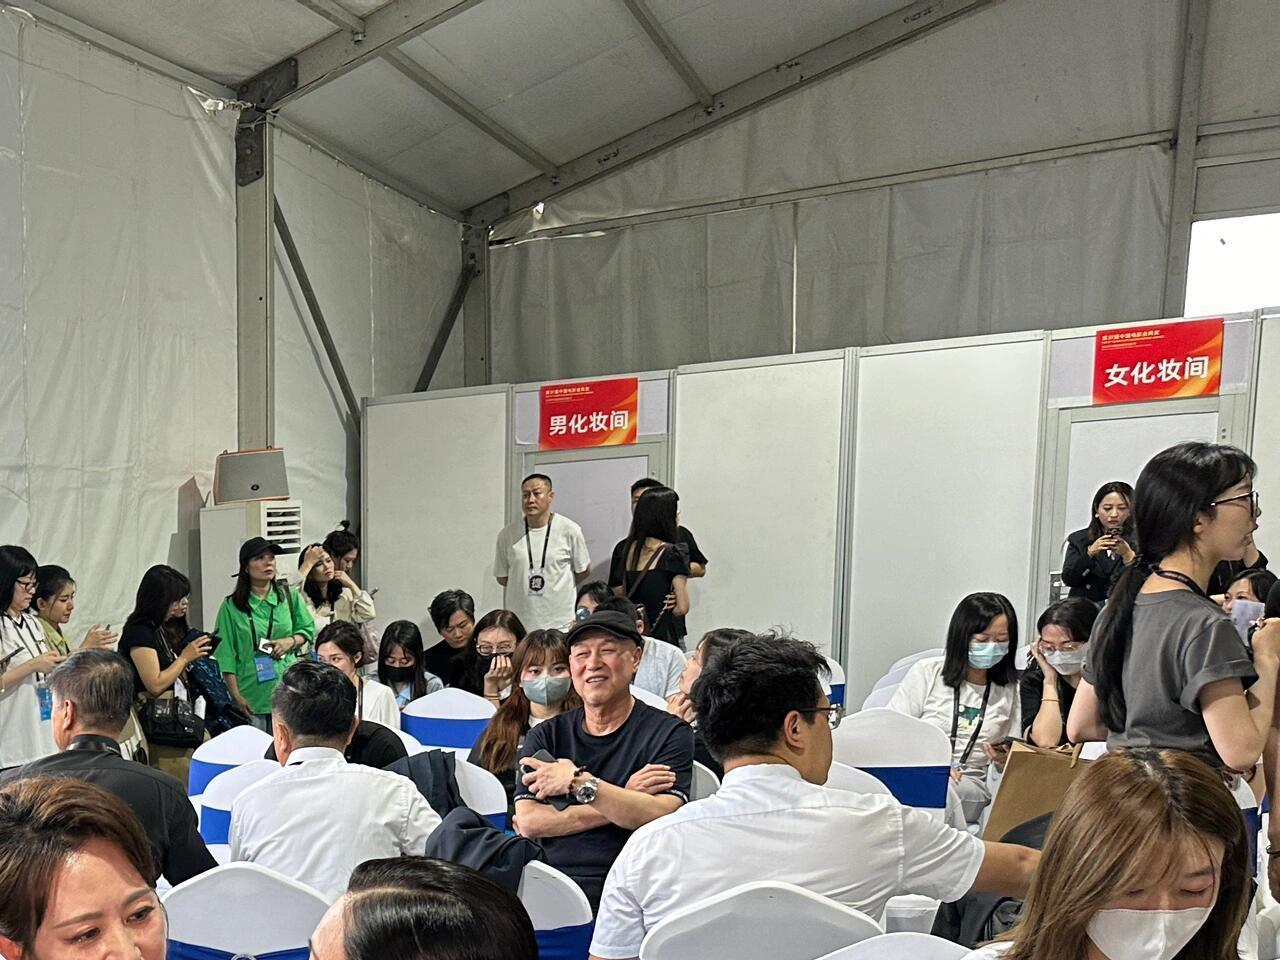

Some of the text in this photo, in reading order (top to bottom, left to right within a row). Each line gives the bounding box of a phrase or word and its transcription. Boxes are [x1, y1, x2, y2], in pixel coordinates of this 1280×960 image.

[1104, 356, 1209, 387] 女化妆间
[549, 410, 629, 436] 男化妆间
